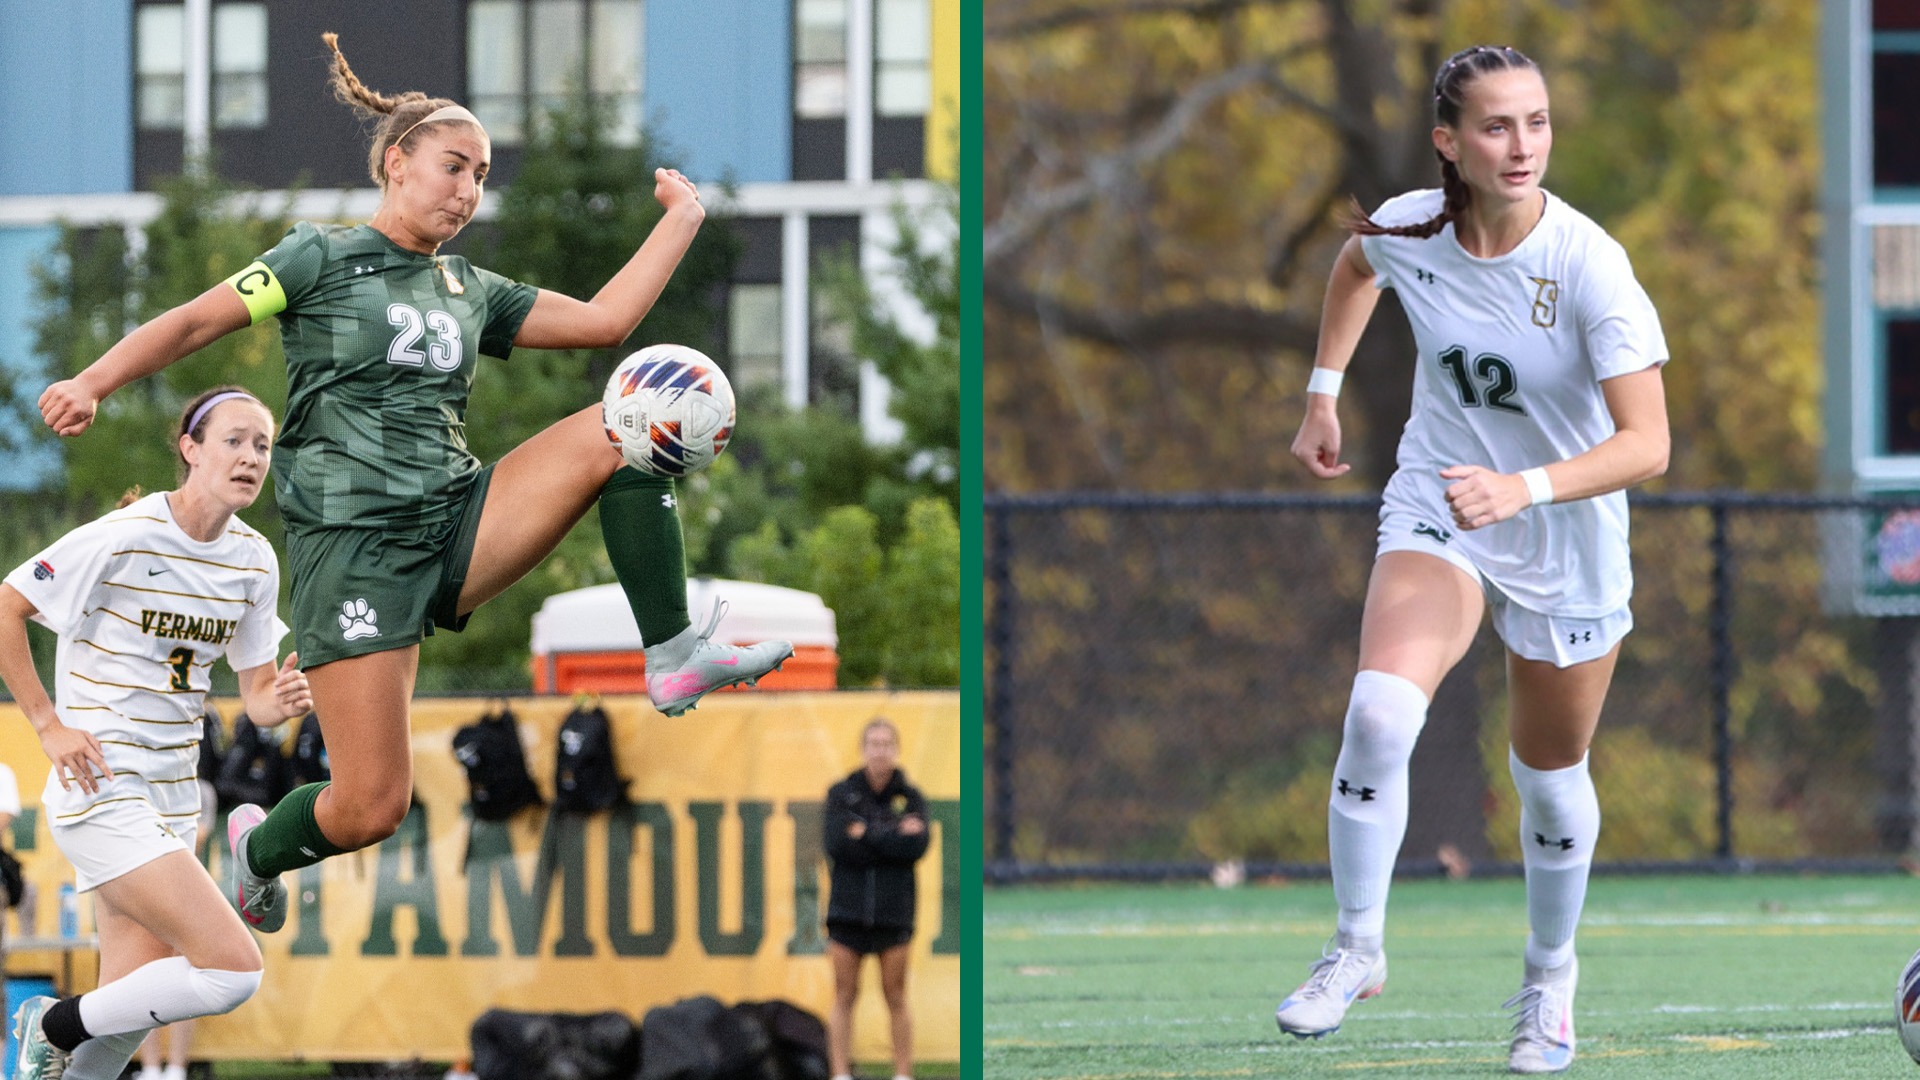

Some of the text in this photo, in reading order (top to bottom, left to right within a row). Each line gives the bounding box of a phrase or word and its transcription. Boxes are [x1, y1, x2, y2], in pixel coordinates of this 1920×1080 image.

[235, 269, 271, 296] C
[387, 303, 463, 372] 23
[1437, 343, 1528, 417] 12
[141, 609, 238, 645] VERMONT
[168, 646, 195, 690] 3
